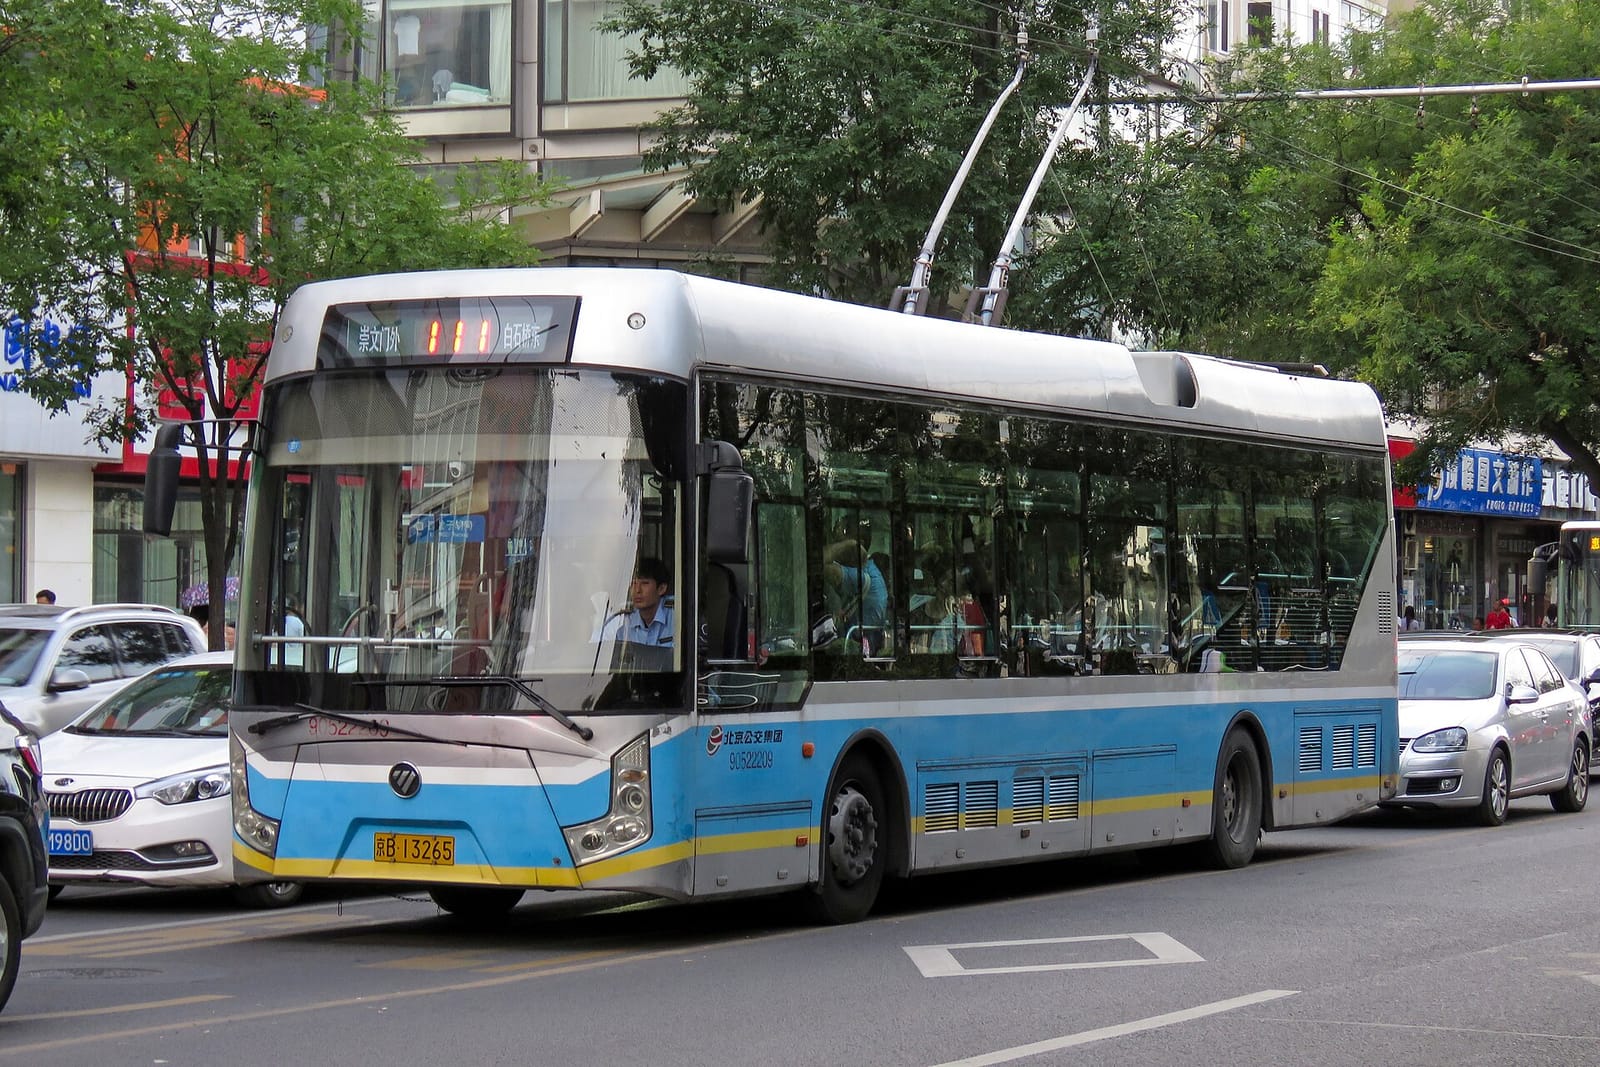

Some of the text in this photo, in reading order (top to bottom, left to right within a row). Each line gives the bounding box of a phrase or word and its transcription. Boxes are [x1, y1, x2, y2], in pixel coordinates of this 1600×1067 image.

[358, 324, 400, 353] 崇文门外
[427, 319, 490, 354] 111
[724, 729, 783, 745] 北京公交集团
[729, 751, 774, 770] 90522209
